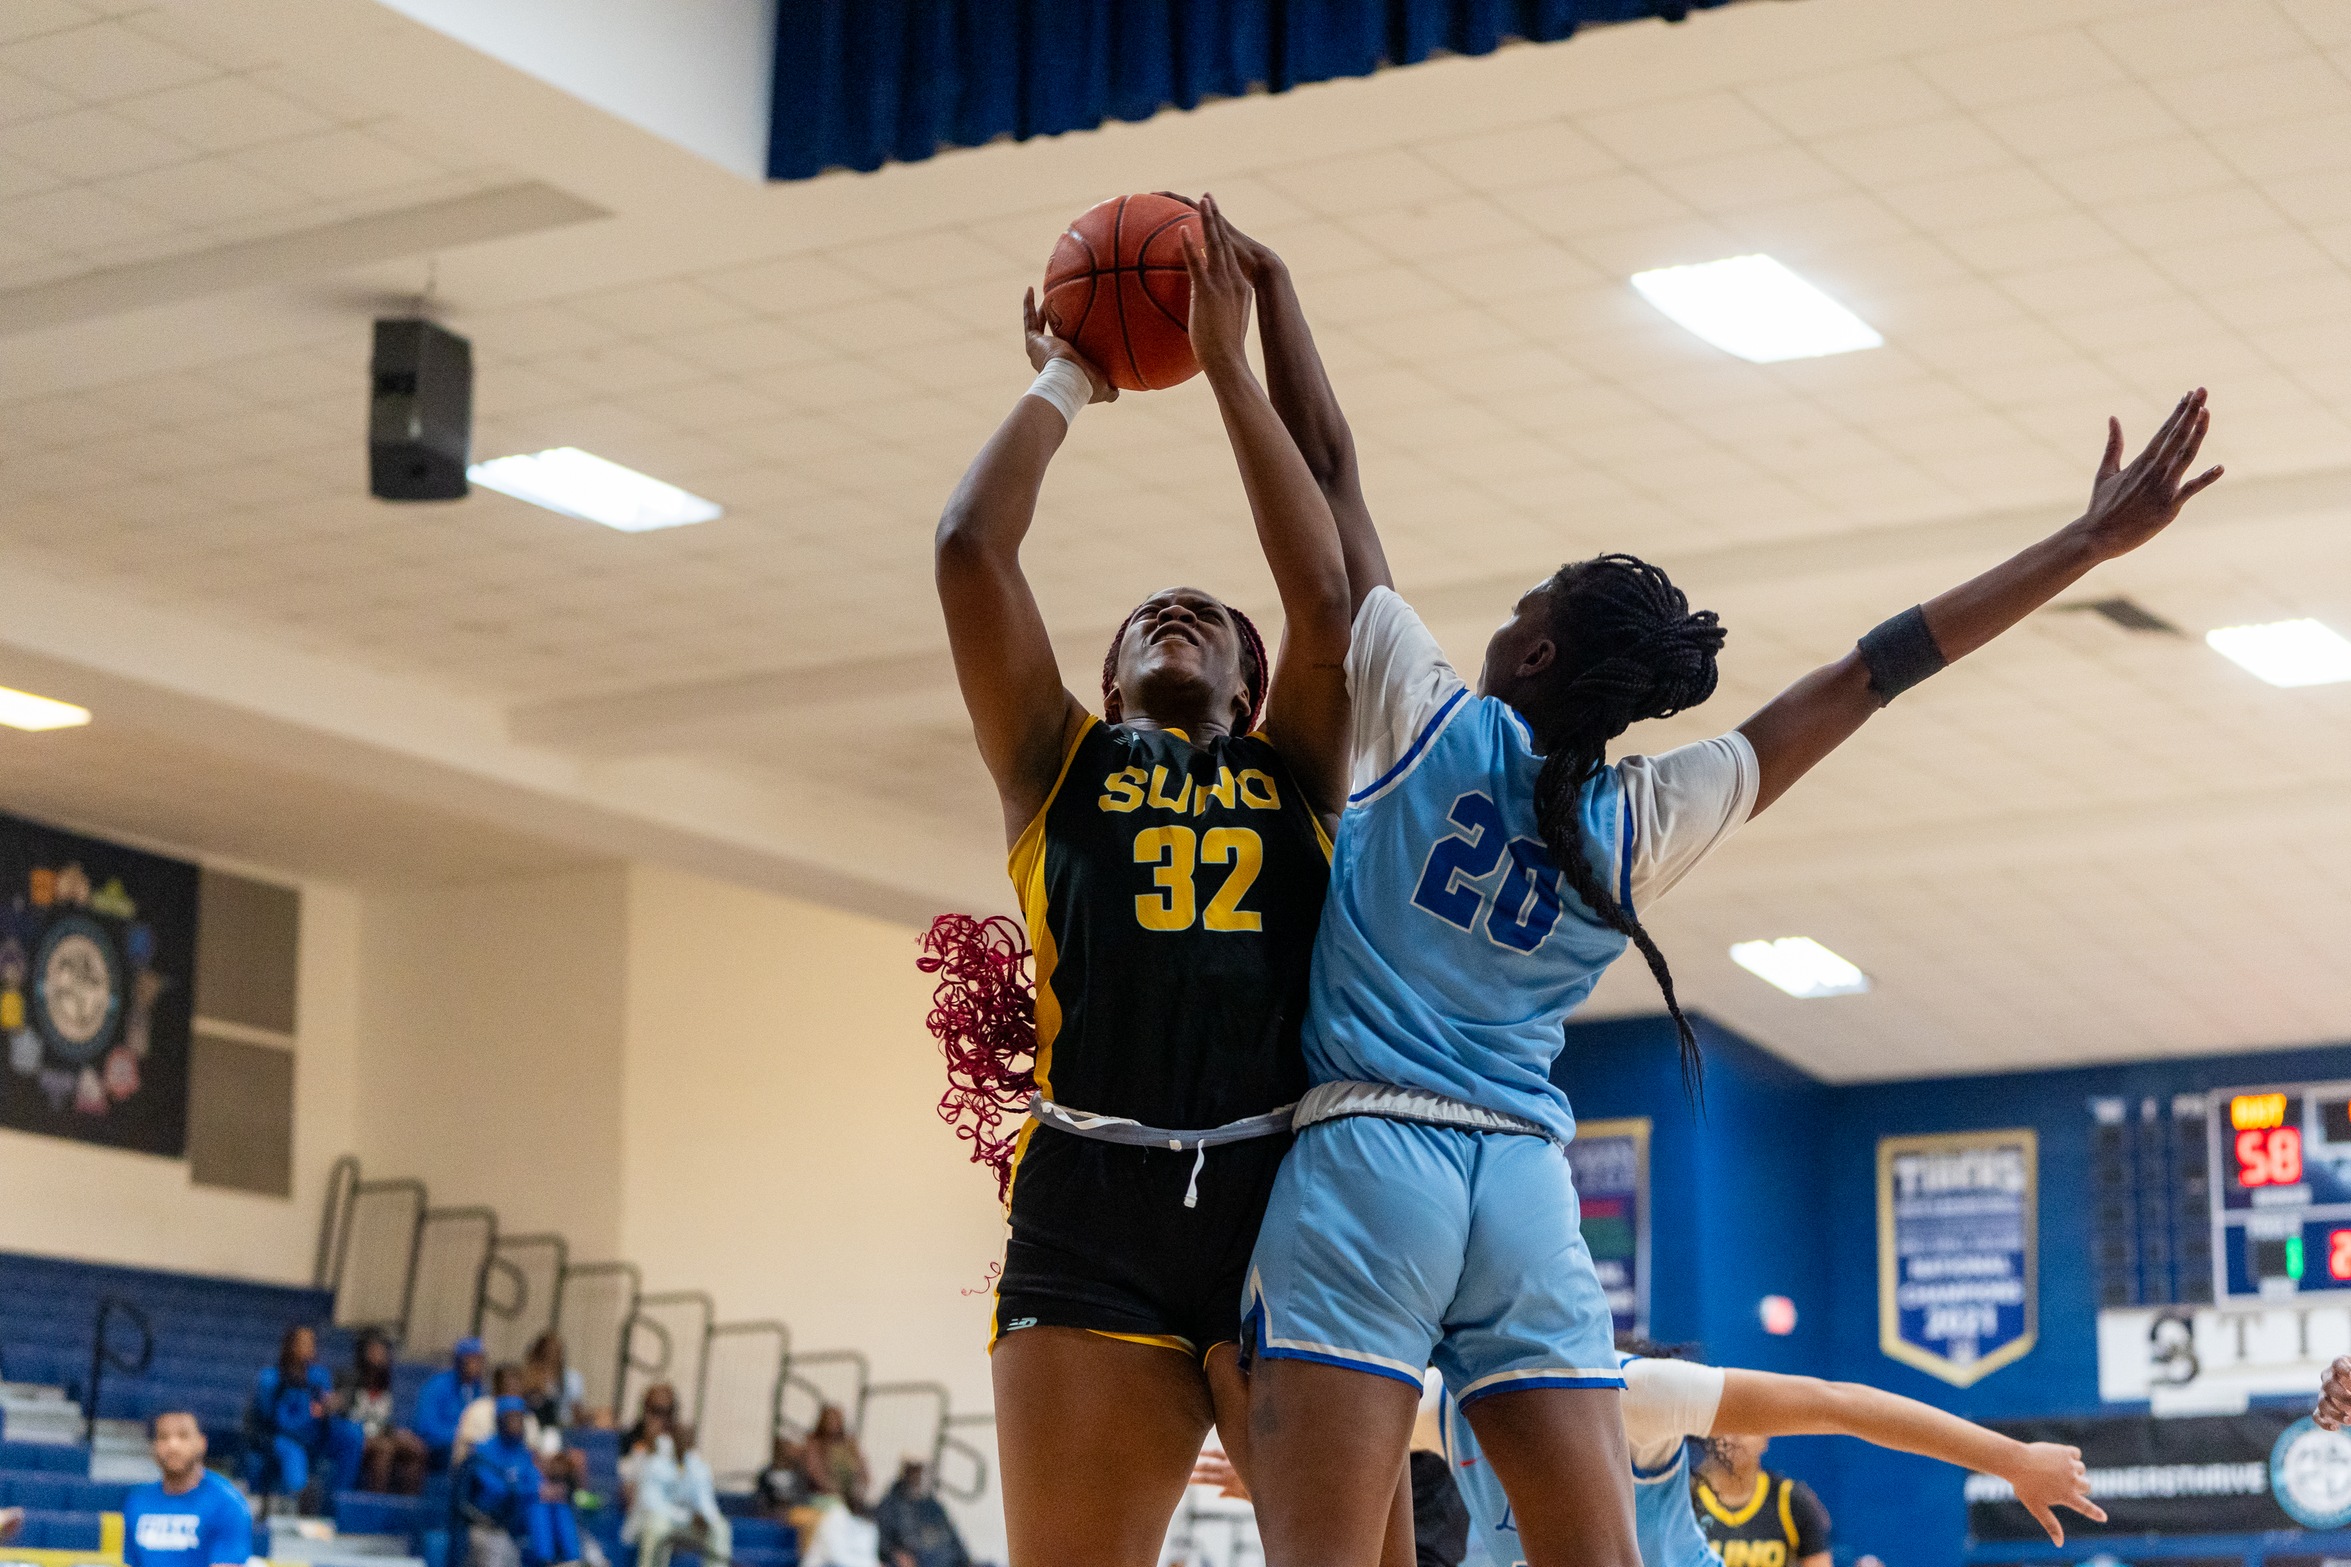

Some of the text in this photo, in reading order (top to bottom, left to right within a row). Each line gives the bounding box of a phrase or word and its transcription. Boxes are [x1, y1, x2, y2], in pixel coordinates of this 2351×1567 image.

[1098, 764, 1282, 817] SUNO
[1133, 825, 1264, 932] 32
[1409, 789, 1564, 957] 20
[2235, 1126, 2303, 1187] 58
